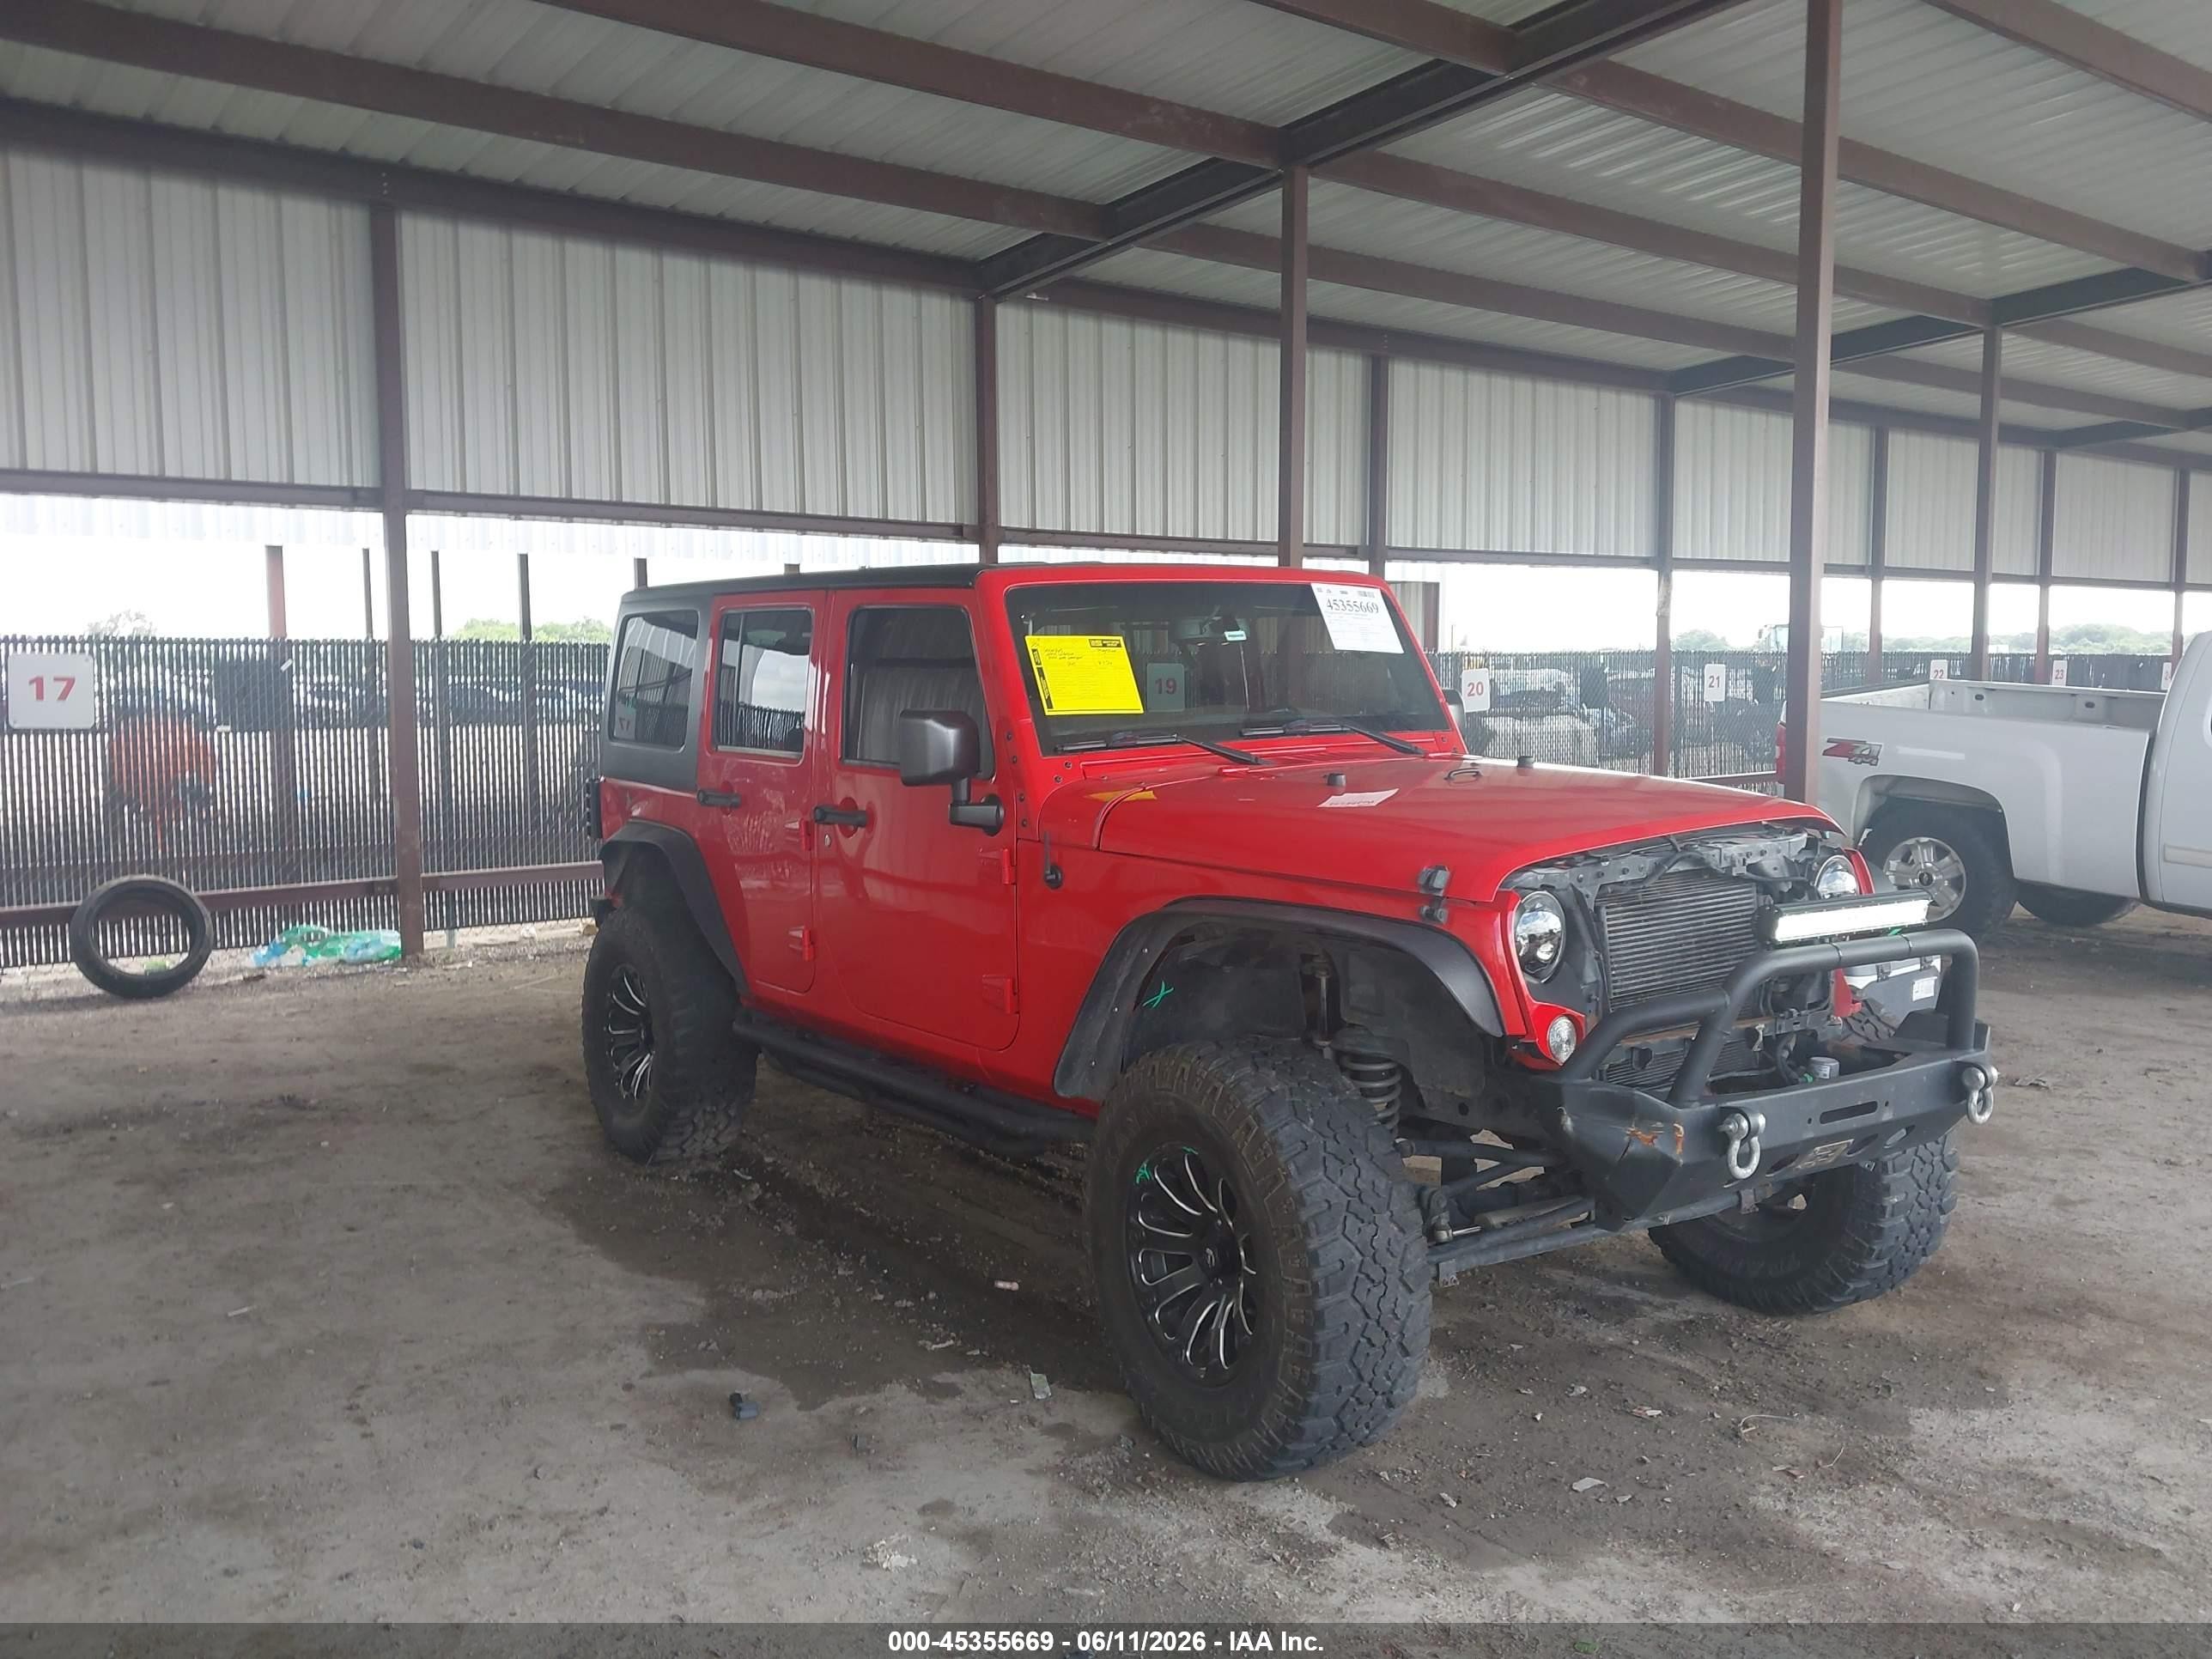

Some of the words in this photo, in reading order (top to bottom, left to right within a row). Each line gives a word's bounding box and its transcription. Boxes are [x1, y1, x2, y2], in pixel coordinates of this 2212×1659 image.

[1326, 599, 1379, 613] 45355669
[1934, 669, 1945, 679] 22
[2055, 669, 2064, 680] 23
[28, 675, 76, 702] 17
[1155, 678, 1177, 695] 19
[1709, 675, 1721, 688] 21
[1467, 681, 1485, 697] 20
